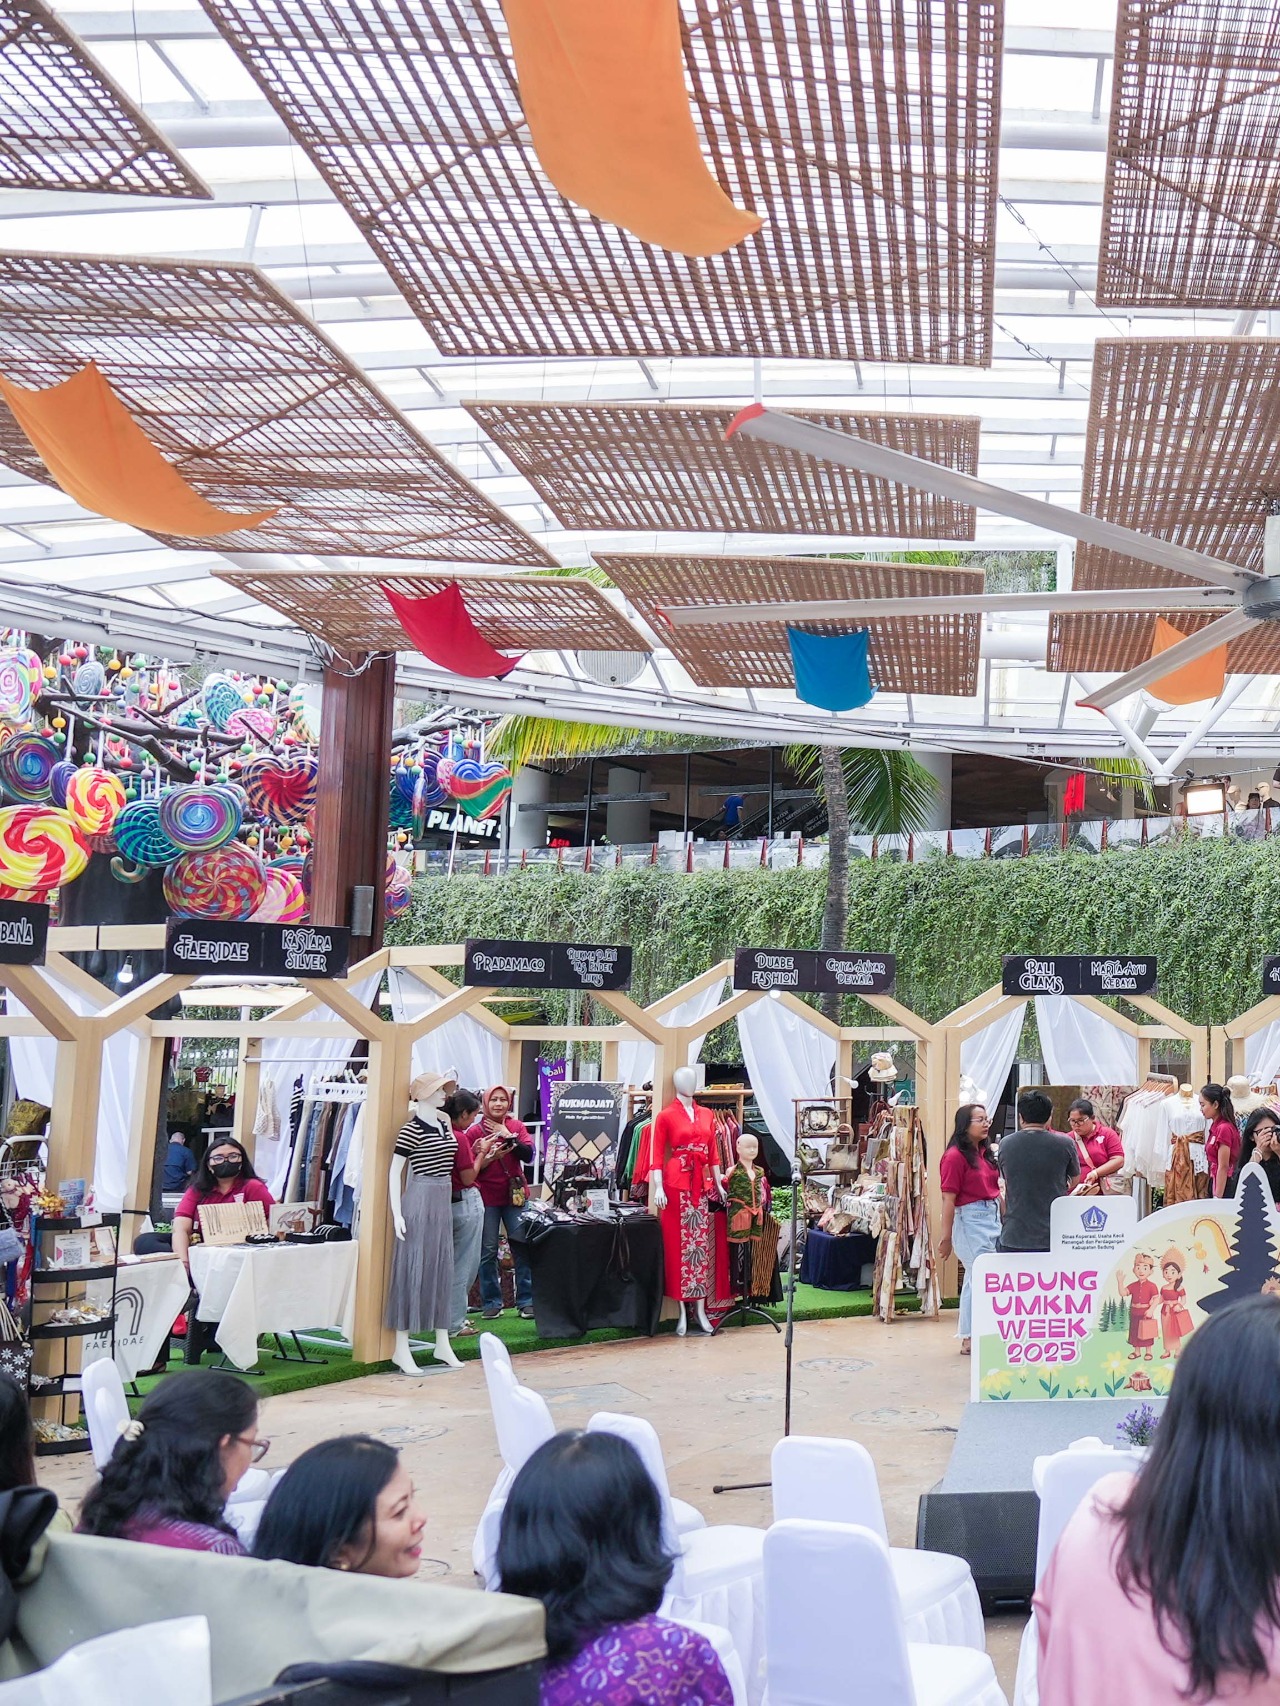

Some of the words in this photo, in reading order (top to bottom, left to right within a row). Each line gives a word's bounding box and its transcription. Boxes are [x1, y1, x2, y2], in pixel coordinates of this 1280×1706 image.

[427, 810, 497, 837] PLANET
[173, 934, 249, 963] FAERIDAE
[282, 929, 332, 953] KASTARA
[285, 951, 327, 972] SILVER
[755, 952, 794, 970] DUABE
[826, 958, 855, 973] GRIYA
[1025, 958, 1055, 976] BALI
[1122, 961, 1147, 976] AYU
[752, 969, 799, 990] FASHION
[1018, 971, 1065, 996] GLAMS
[1101, 974, 1137, 990] KEBAYA
[558, 1098, 615, 1108] RUKMADJATI
[985, 1271, 1098, 1293] BADUNG
[992, 1294, 1091, 1316] UMKM
[997, 1317, 1087, 1340] WEEK
[1007, 1341, 1076, 1363] 2025
